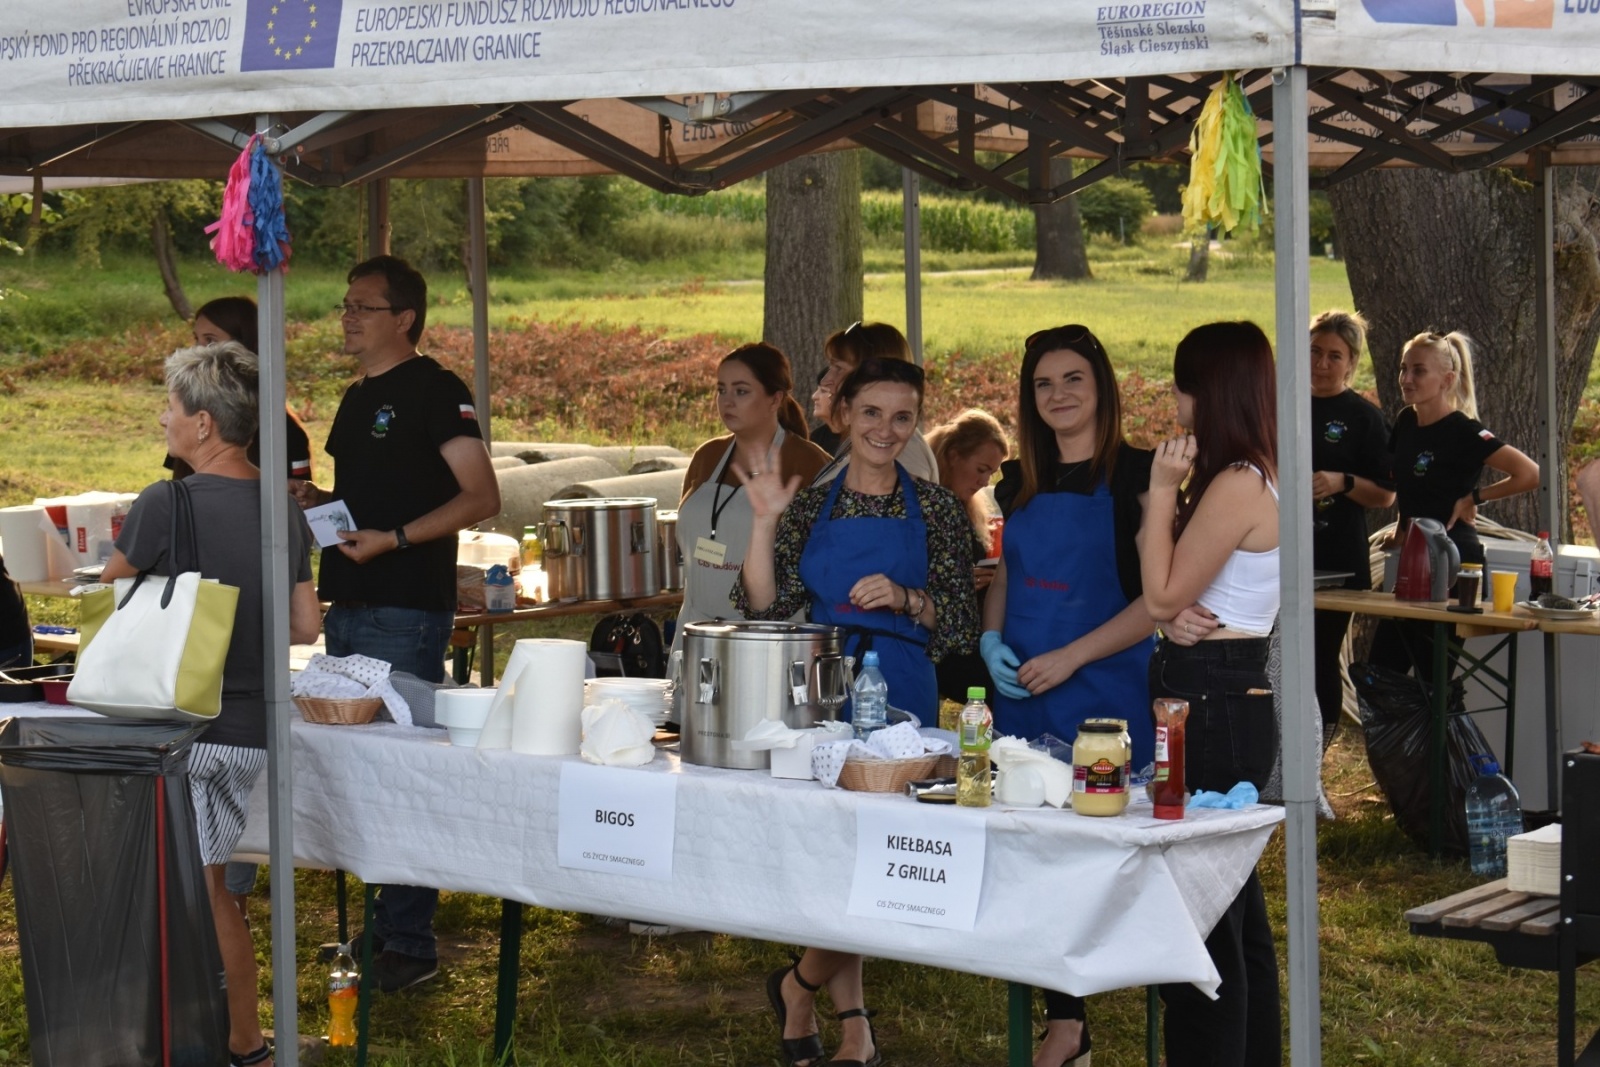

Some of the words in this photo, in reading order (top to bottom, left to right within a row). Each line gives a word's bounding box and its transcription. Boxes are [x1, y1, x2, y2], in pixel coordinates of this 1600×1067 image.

[355, 3, 442, 33] EUROPEJSKI
[445, 0, 518, 28] FUNDUSZ
[1097, 1, 1206, 21] EUROREGION
[0, 29, 30, 61] PSKÝ
[33, 33, 69, 58] FOND
[71, 30, 97, 54] PRO
[100, 16, 179, 52] REGIONÁLNÍ
[181, 17, 231, 45] ROZVOJ
[1098, 22, 1154, 40] Těšínské
[1156, 20, 1206, 36] Slezsko
[351, 36, 469, 67] PRZEKRACZAMY
[472, 32, 542, 61] GRANICE
[1100, 40, 1135, 57] Śląsk
[1139, 36, 1209, 54] Cieszyński
[68, 53, 166, 87] PŘEKRAČUJEME
[168, 50, 227, 78] HRANICE
[595, 809, 635, 827] BIGOS
[887, 835, 953, 857] KIEŁBASA
[582, 851, 592, 859] CIS
[592, 852, 609, 862] ŻYCZY
[609, 855, 646, 867] SMACZNEGO
[886, 862, 896, 877] Z
[898, 864, 946, 884] GRILLA
[876, 900, 886, 908] CIS
[887, 900, 906, 911] ŻYCZY
[906, 903, 946, 916] SMACZNEGO
